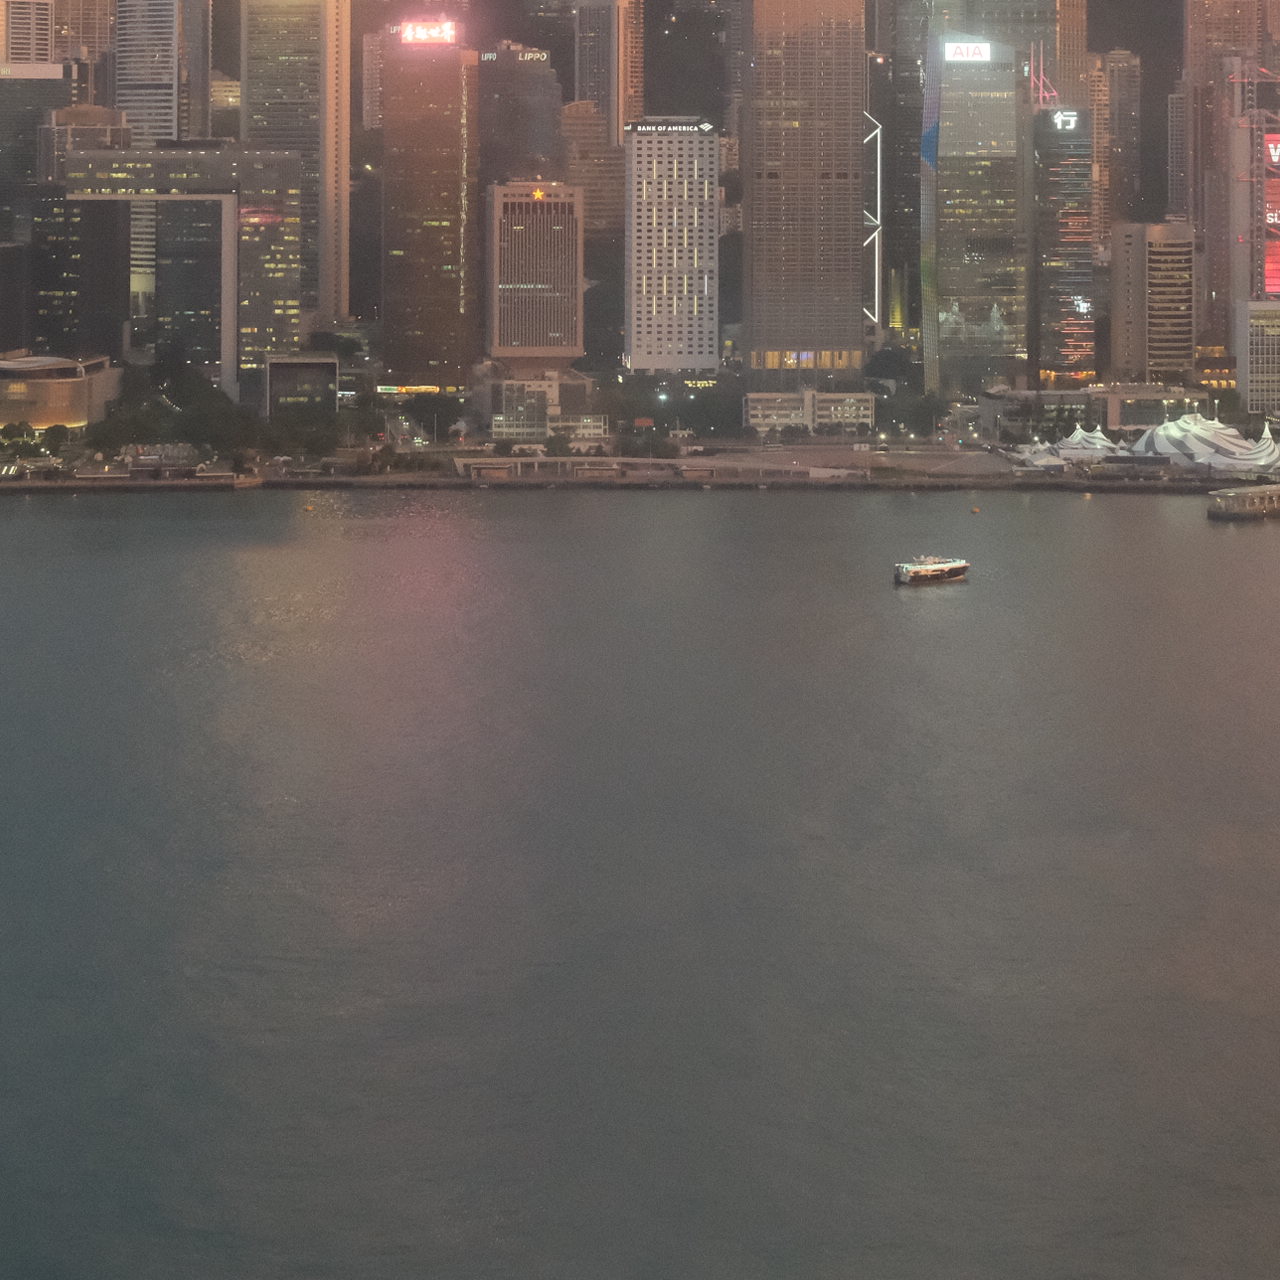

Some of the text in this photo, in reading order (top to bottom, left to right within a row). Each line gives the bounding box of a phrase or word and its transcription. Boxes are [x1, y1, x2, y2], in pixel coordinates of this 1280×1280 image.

[481, 52, 497, 61] LIPPO
[518, 52, 547, 61] LIPPO
[953, 45, 983, 58] AIA
[1053, 110, 1078, 130] 行
